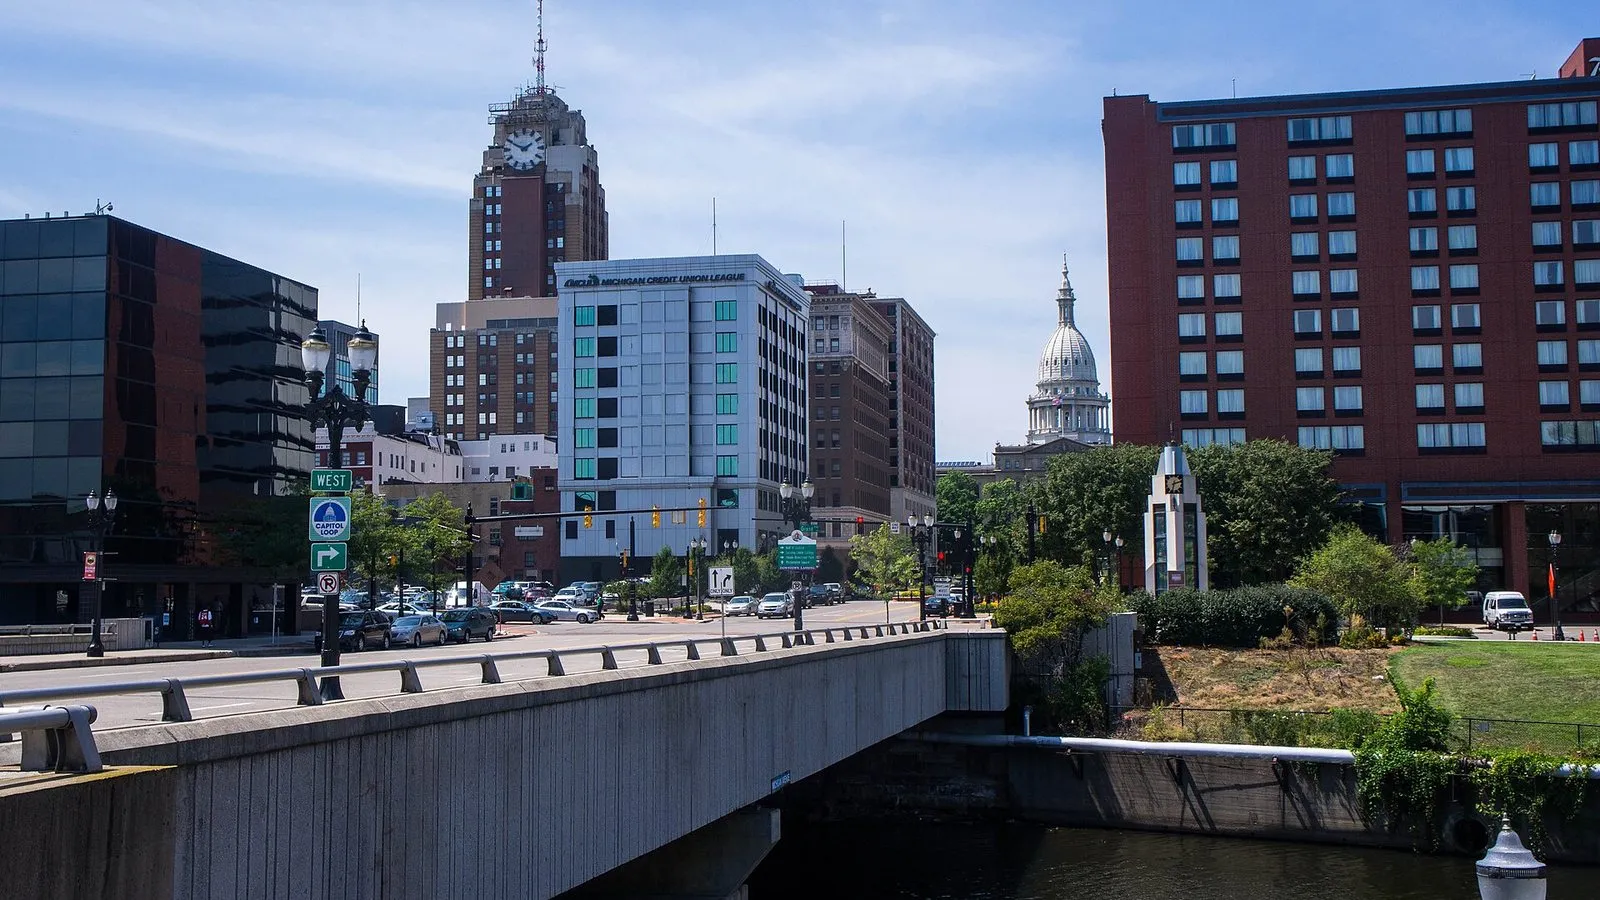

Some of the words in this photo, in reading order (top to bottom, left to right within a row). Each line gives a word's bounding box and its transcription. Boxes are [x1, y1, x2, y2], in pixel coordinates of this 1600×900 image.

[601, 276, 645, 286] MICHIGAN
[647, 275, 678, 285] CREDIT
[679, 274, 709, 283] UNION
[710, 273, 745, 282] LEAGUE
[317, 475, 346, 487] WEST
